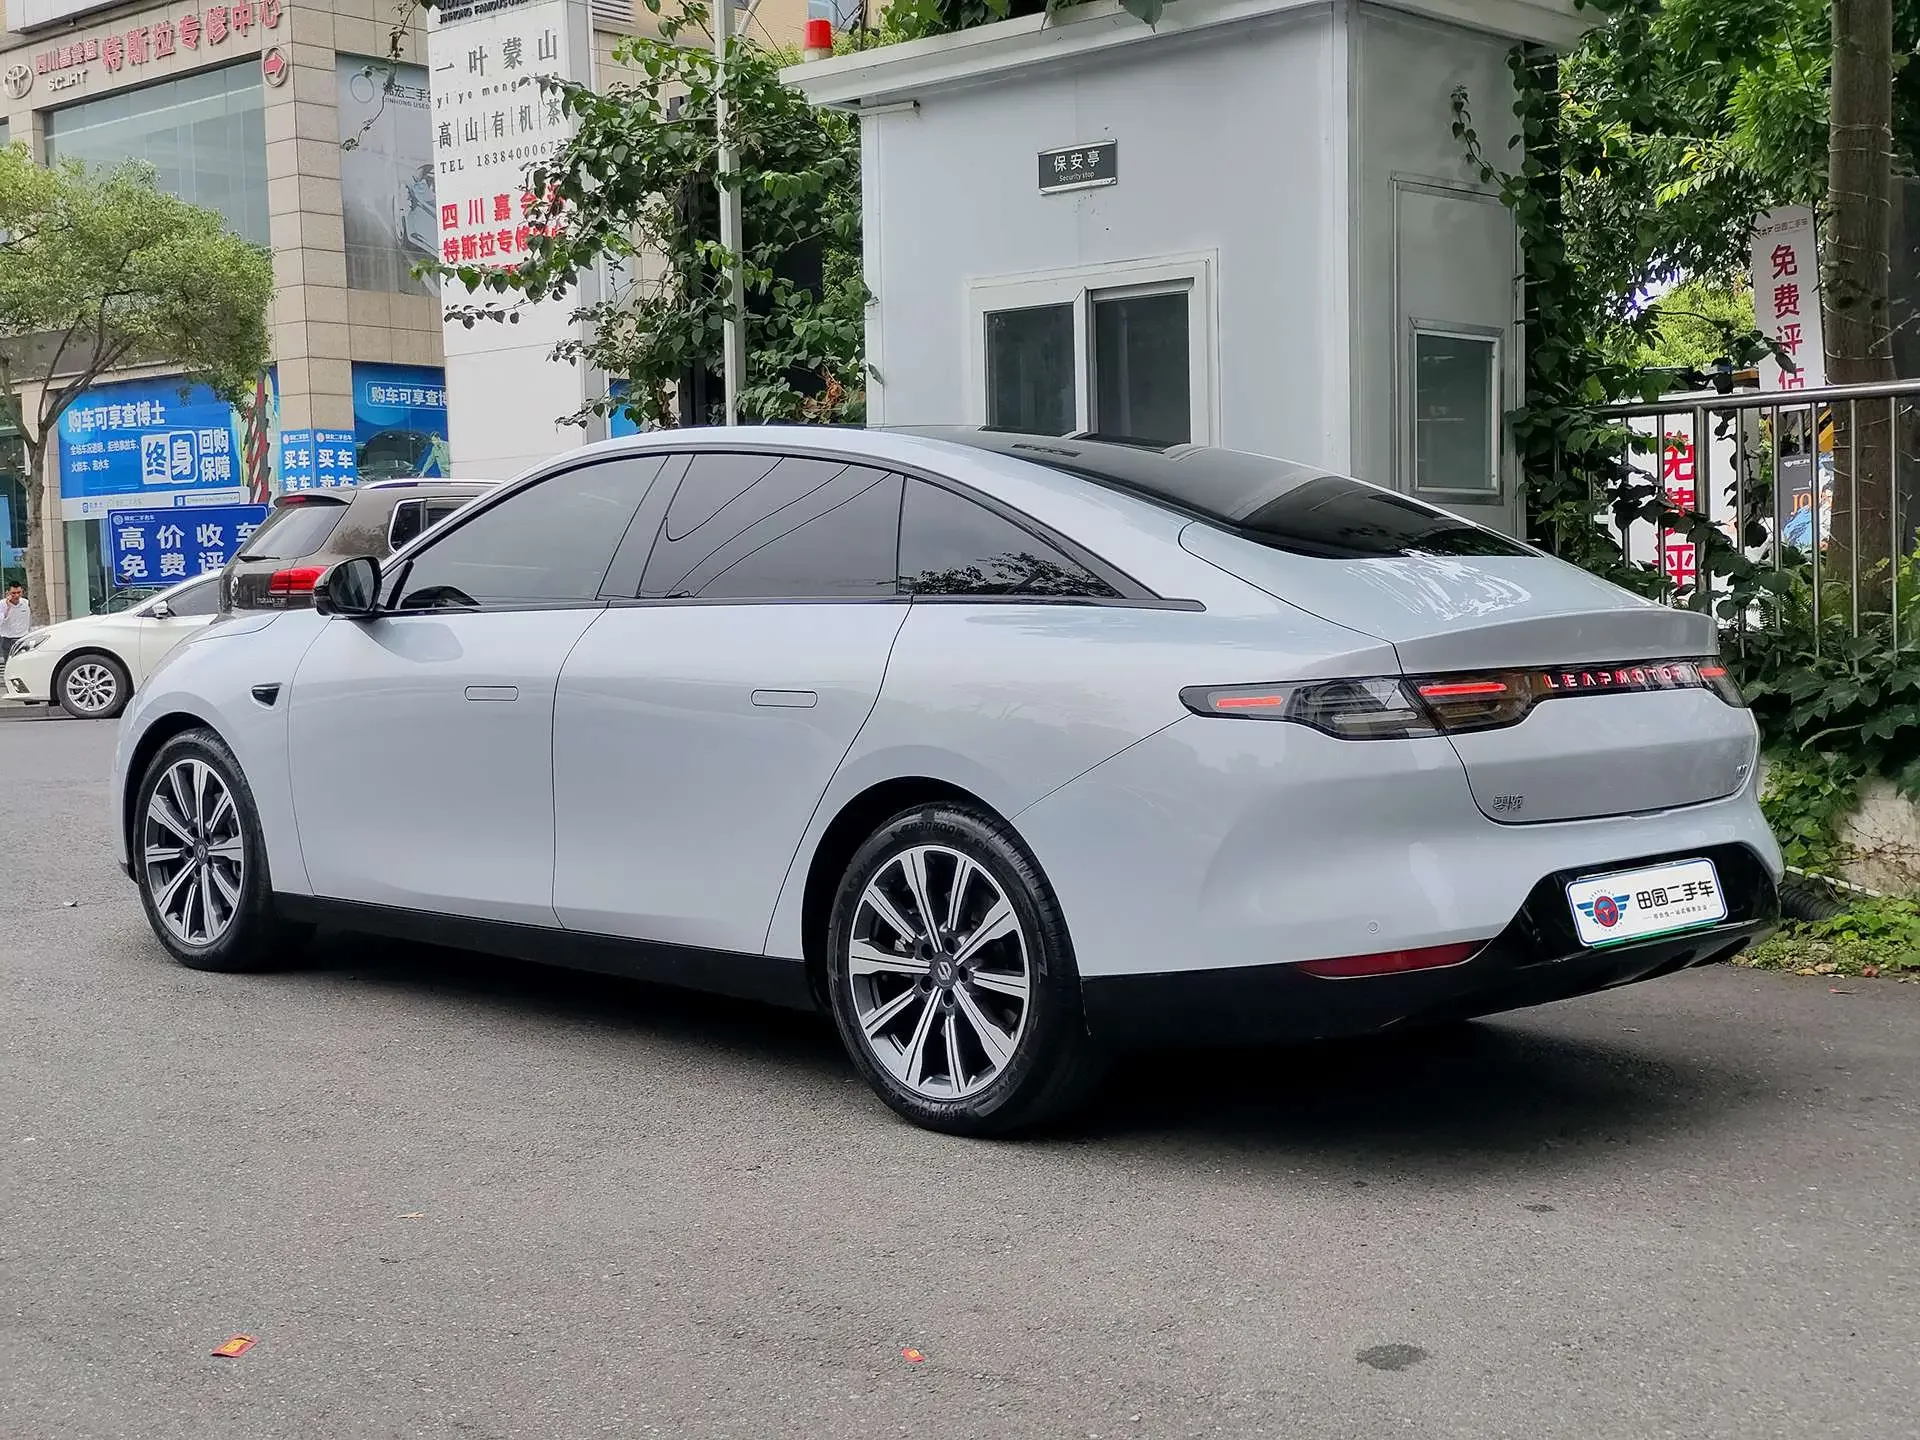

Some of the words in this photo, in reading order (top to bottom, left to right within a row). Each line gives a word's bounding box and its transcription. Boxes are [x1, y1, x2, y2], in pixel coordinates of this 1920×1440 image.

[101, 0, 282, 73] 特斯拉专修中心
[435, 28, 559, 77] 一叶蒙山
[436, 92, 450, 109] yi
[440, 155, 466, 174] TEL
[1053, 150, 1101, 173] 保安亭
[68, 399, 166, 433] 购车可享查博士
[199, 427, 229, 456] 回购
[145, 438, 194, 478] 终身
[200, 456, 231, 482] 保障
[284, 448, 311, 470] 买车
[318, 448, 354, 469] 买车
[119, 522, 260, 550] 高价收车
[1635, 880, 1715, 910] 田园二手车
